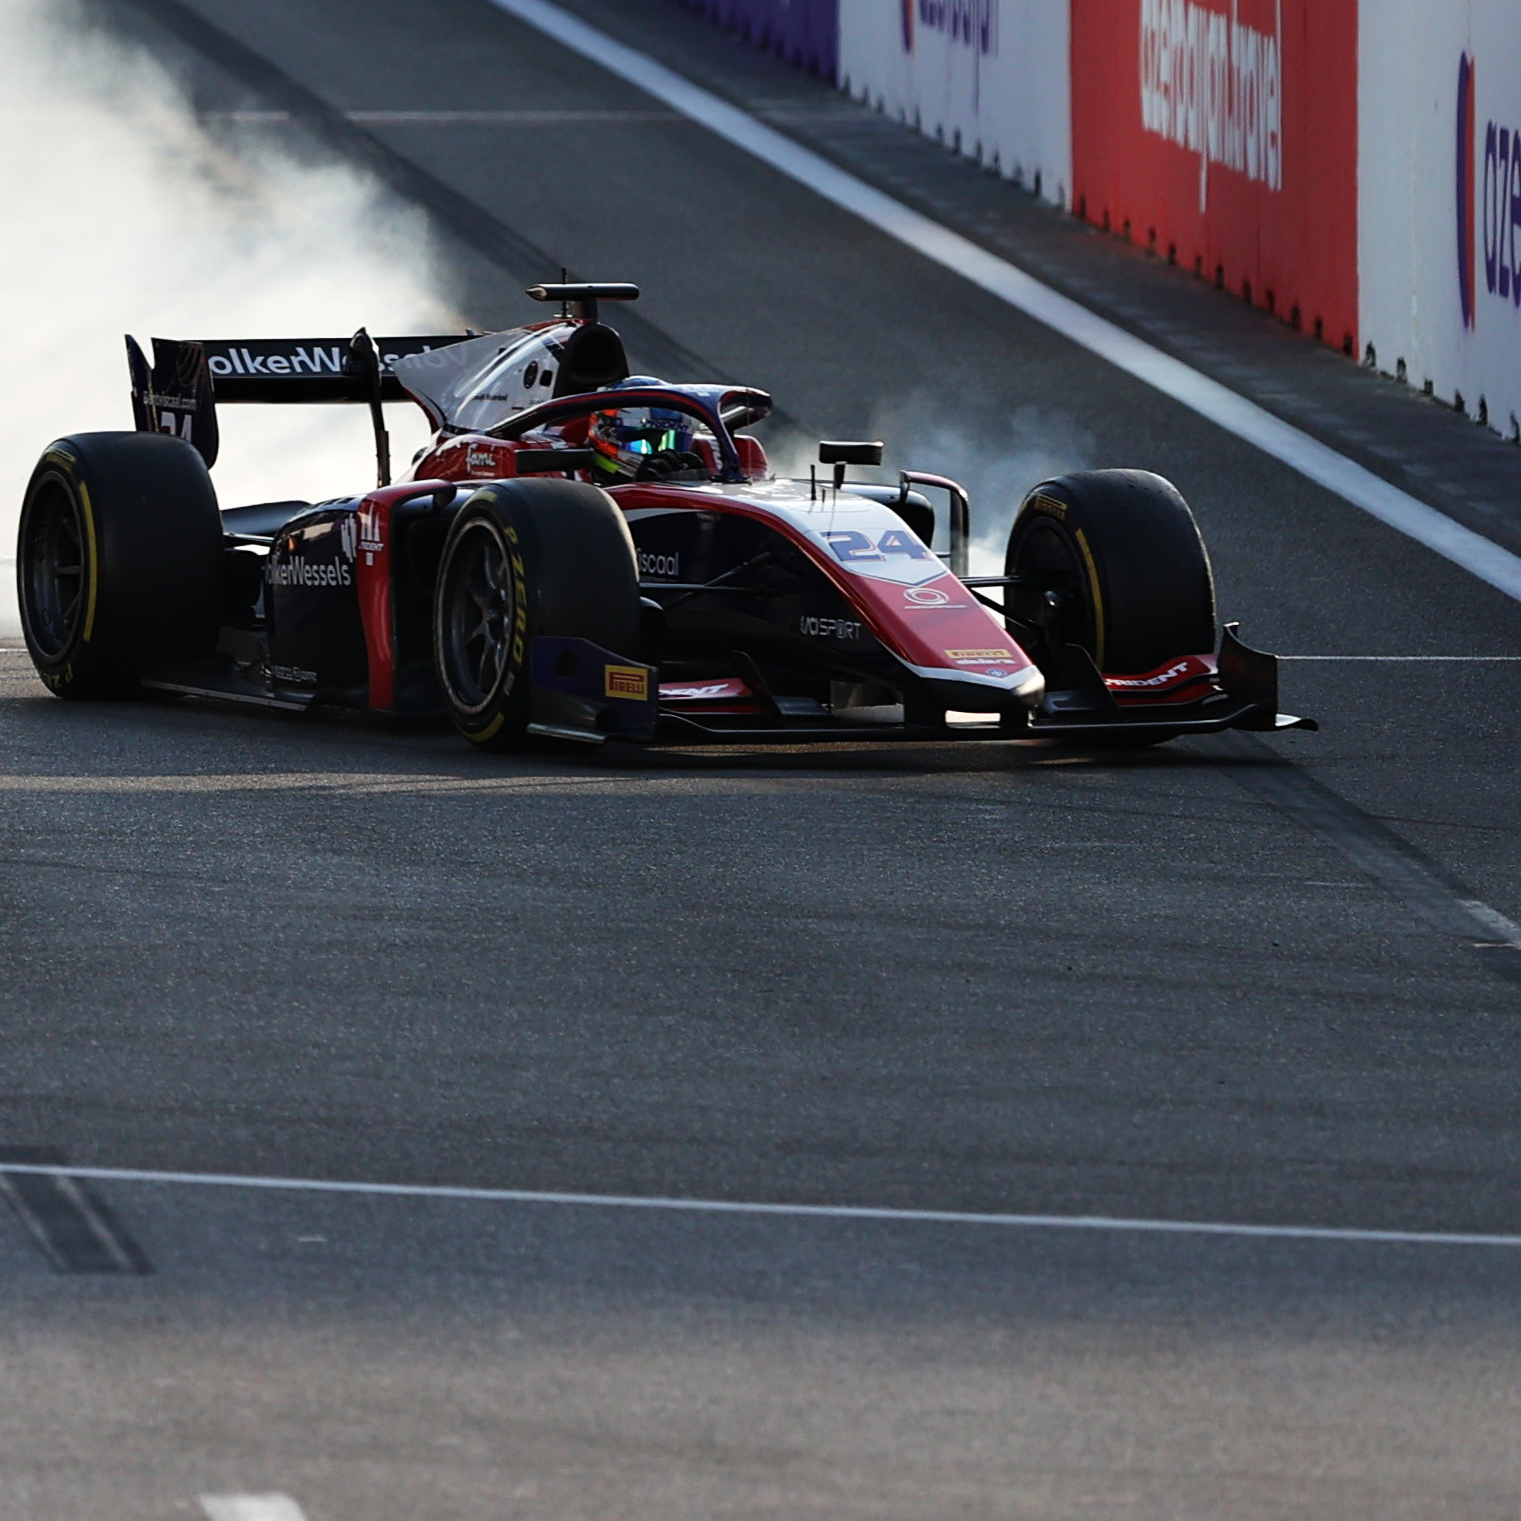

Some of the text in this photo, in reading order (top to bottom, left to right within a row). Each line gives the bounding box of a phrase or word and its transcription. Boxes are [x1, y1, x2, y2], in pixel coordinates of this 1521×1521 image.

[821, 530, 934, 562] 24
[638, 547, 680, 577] iscaal
[608, 671, 646, 695] PIRELLI
